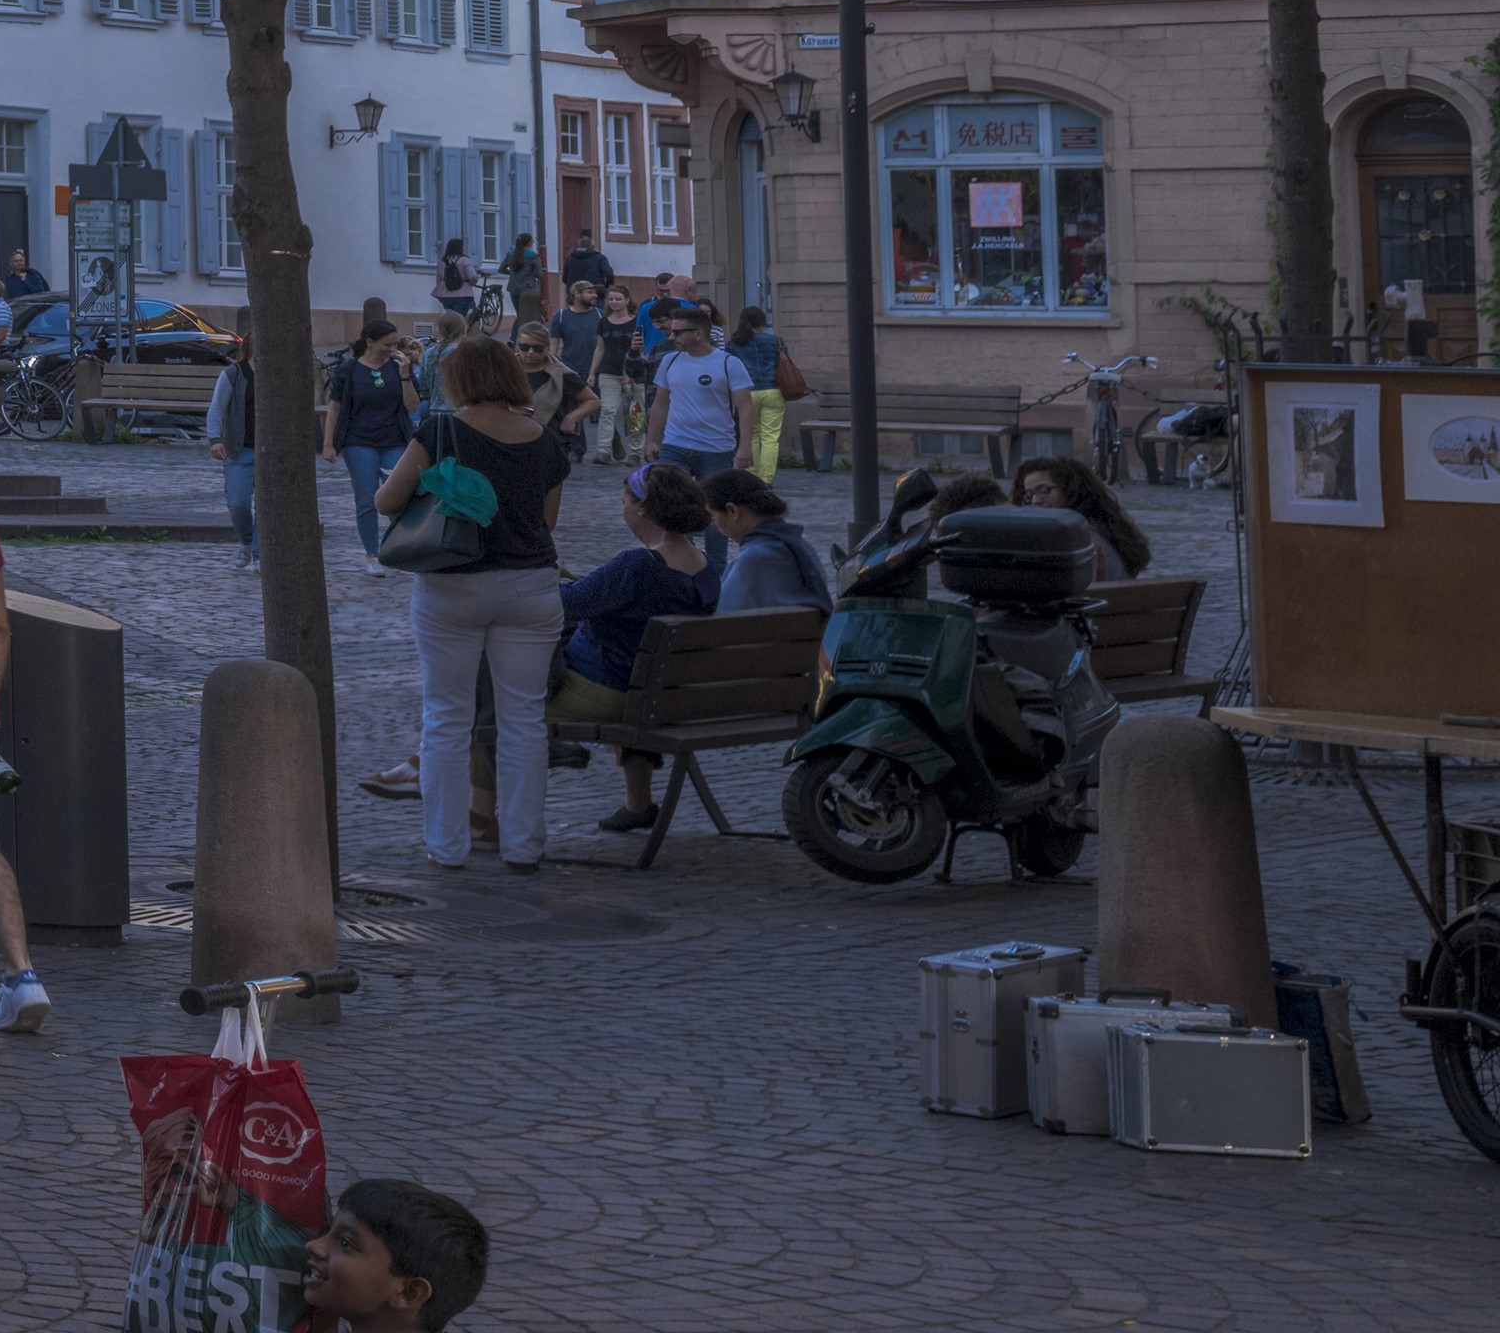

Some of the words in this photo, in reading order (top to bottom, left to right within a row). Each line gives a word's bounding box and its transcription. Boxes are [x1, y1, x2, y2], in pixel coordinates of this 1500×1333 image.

[801, 34, 838, 46] Kornmar
[1389, 62, 1401, 78] 3
[893, 128, 928, 152] 선
[956, 120, 1033, 148] 免税店
[90, 301, 115, 313] ZONE
[244, 1116, 296, 1149] C&A
[241, 1169, 270, 1181] GOOD
[271, 1173, 307, 1186] FASHION
